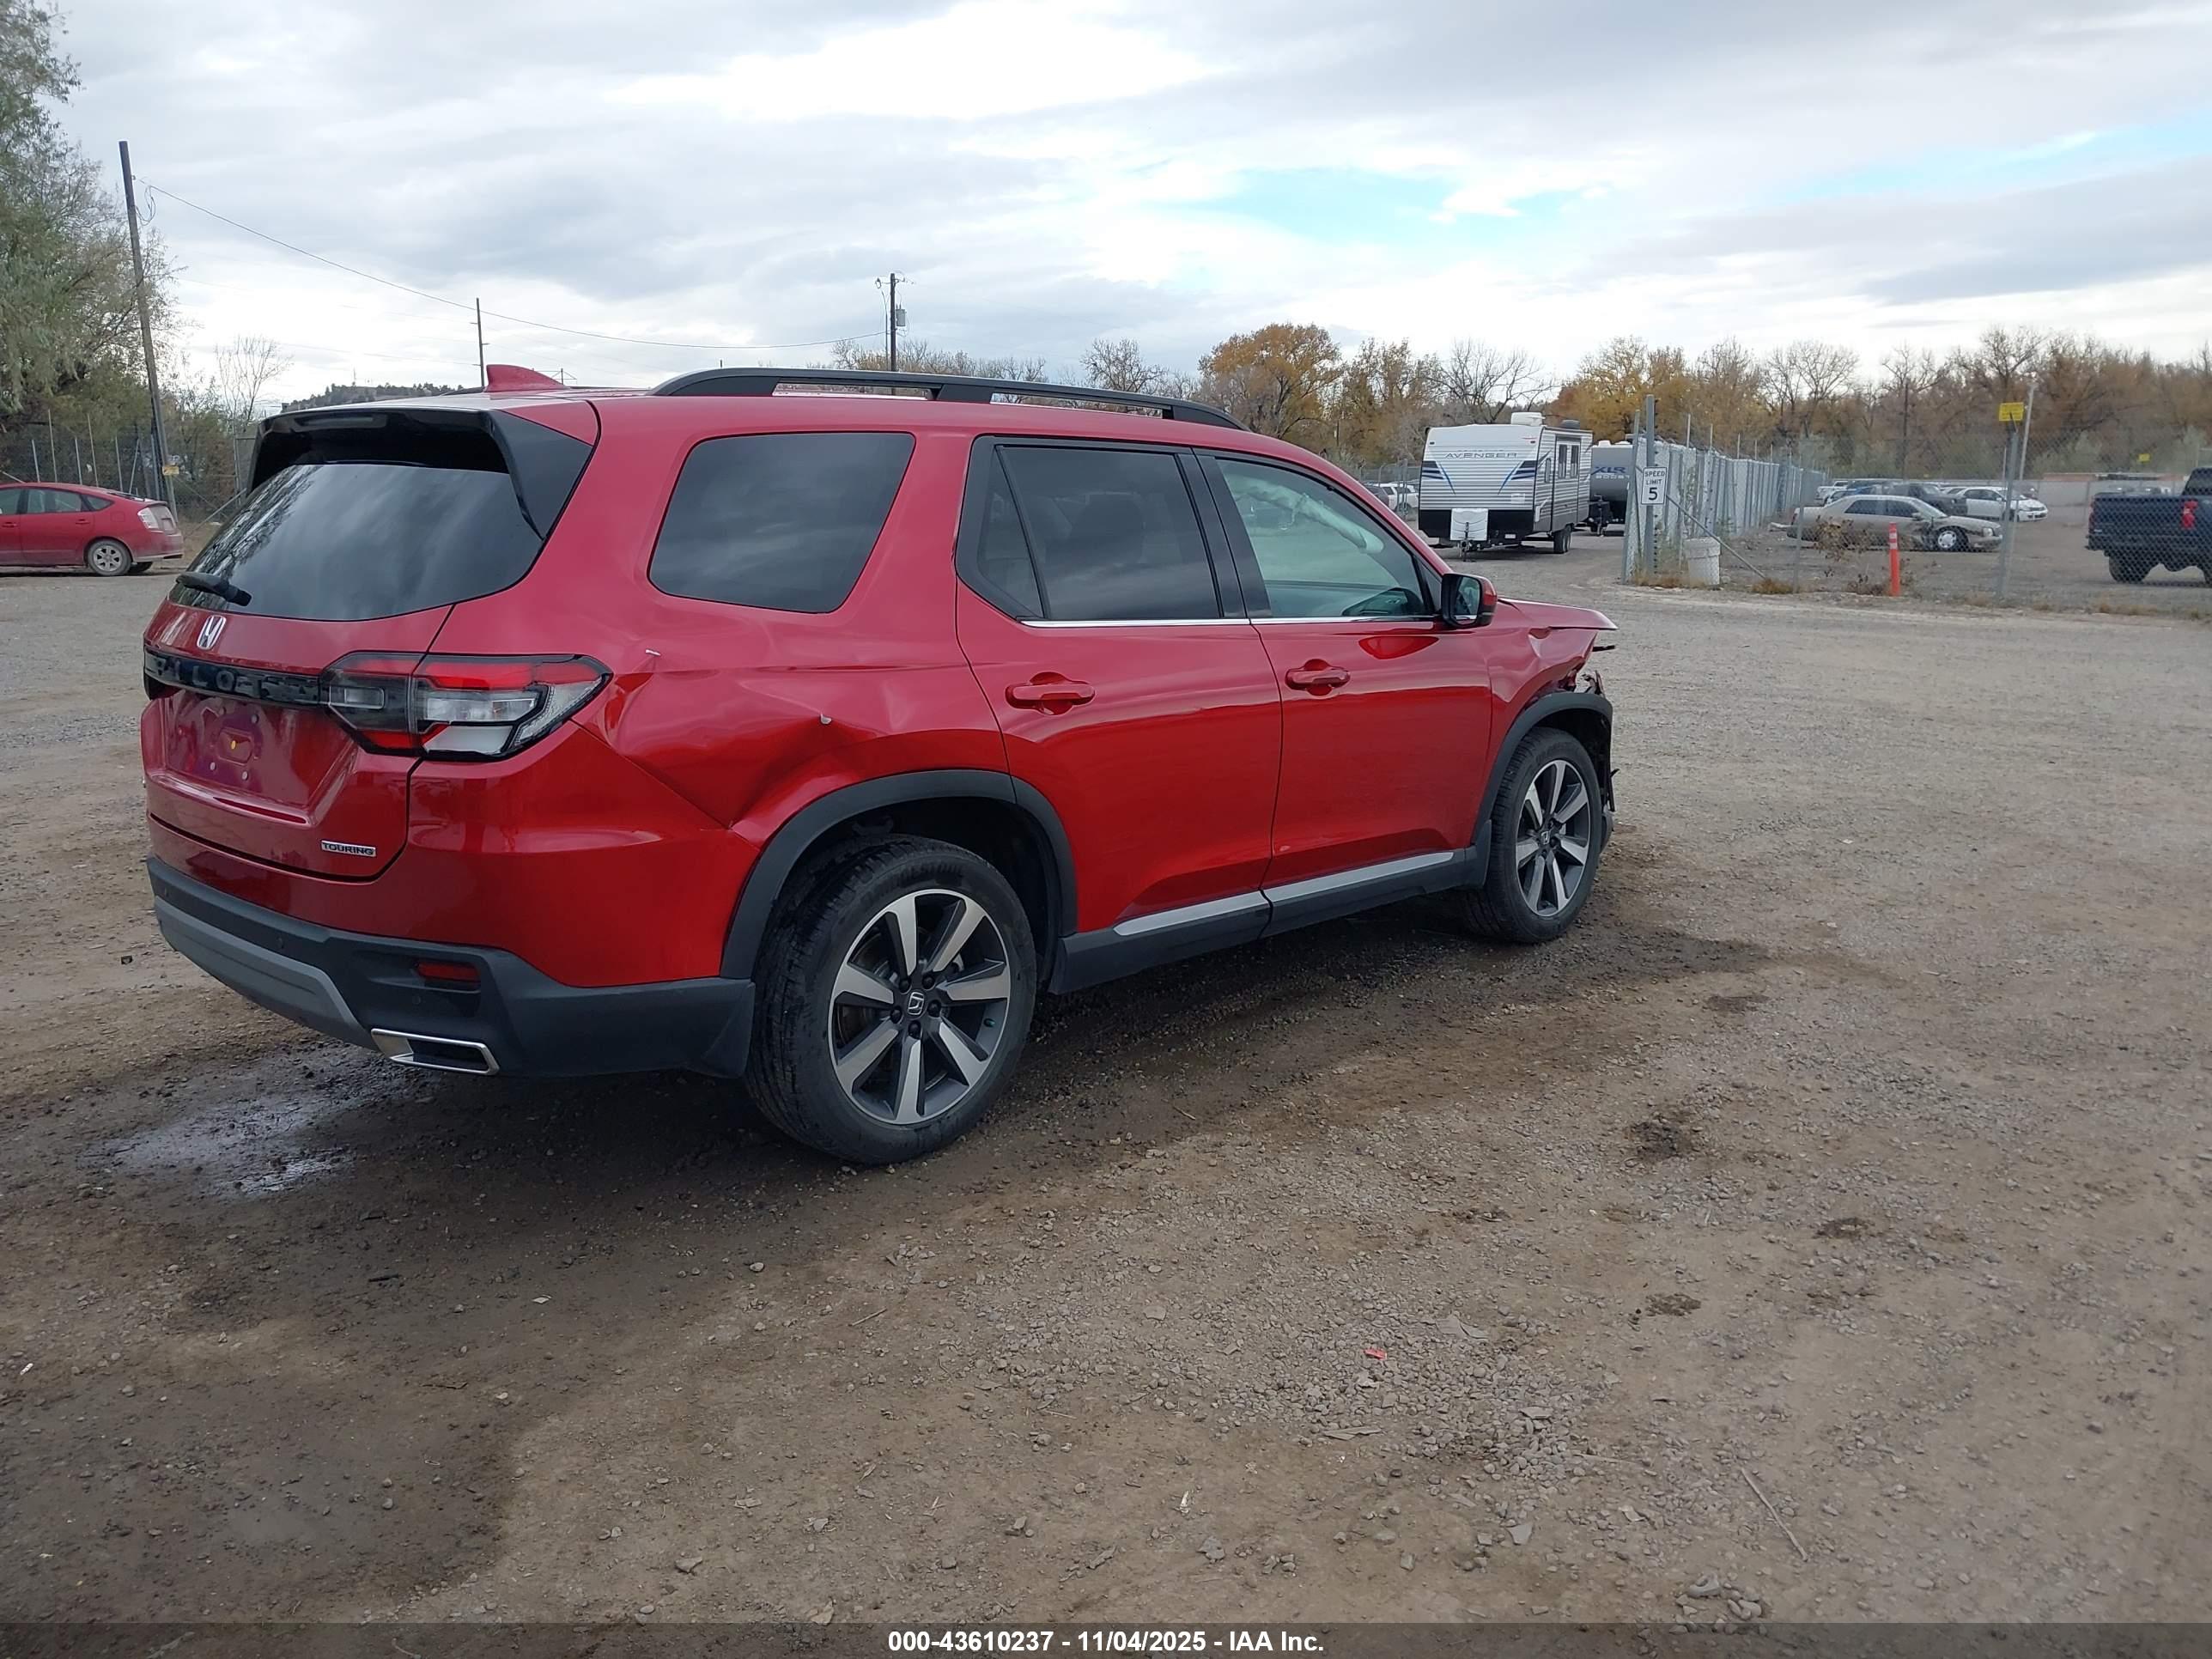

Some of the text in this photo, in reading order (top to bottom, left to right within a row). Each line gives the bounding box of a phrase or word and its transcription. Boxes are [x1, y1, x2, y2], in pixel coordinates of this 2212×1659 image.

[1591, 466, 1626, 476] XLR
[1649, 487, 1658, 501] 5
[322, 842, 374, 855] TOURING
